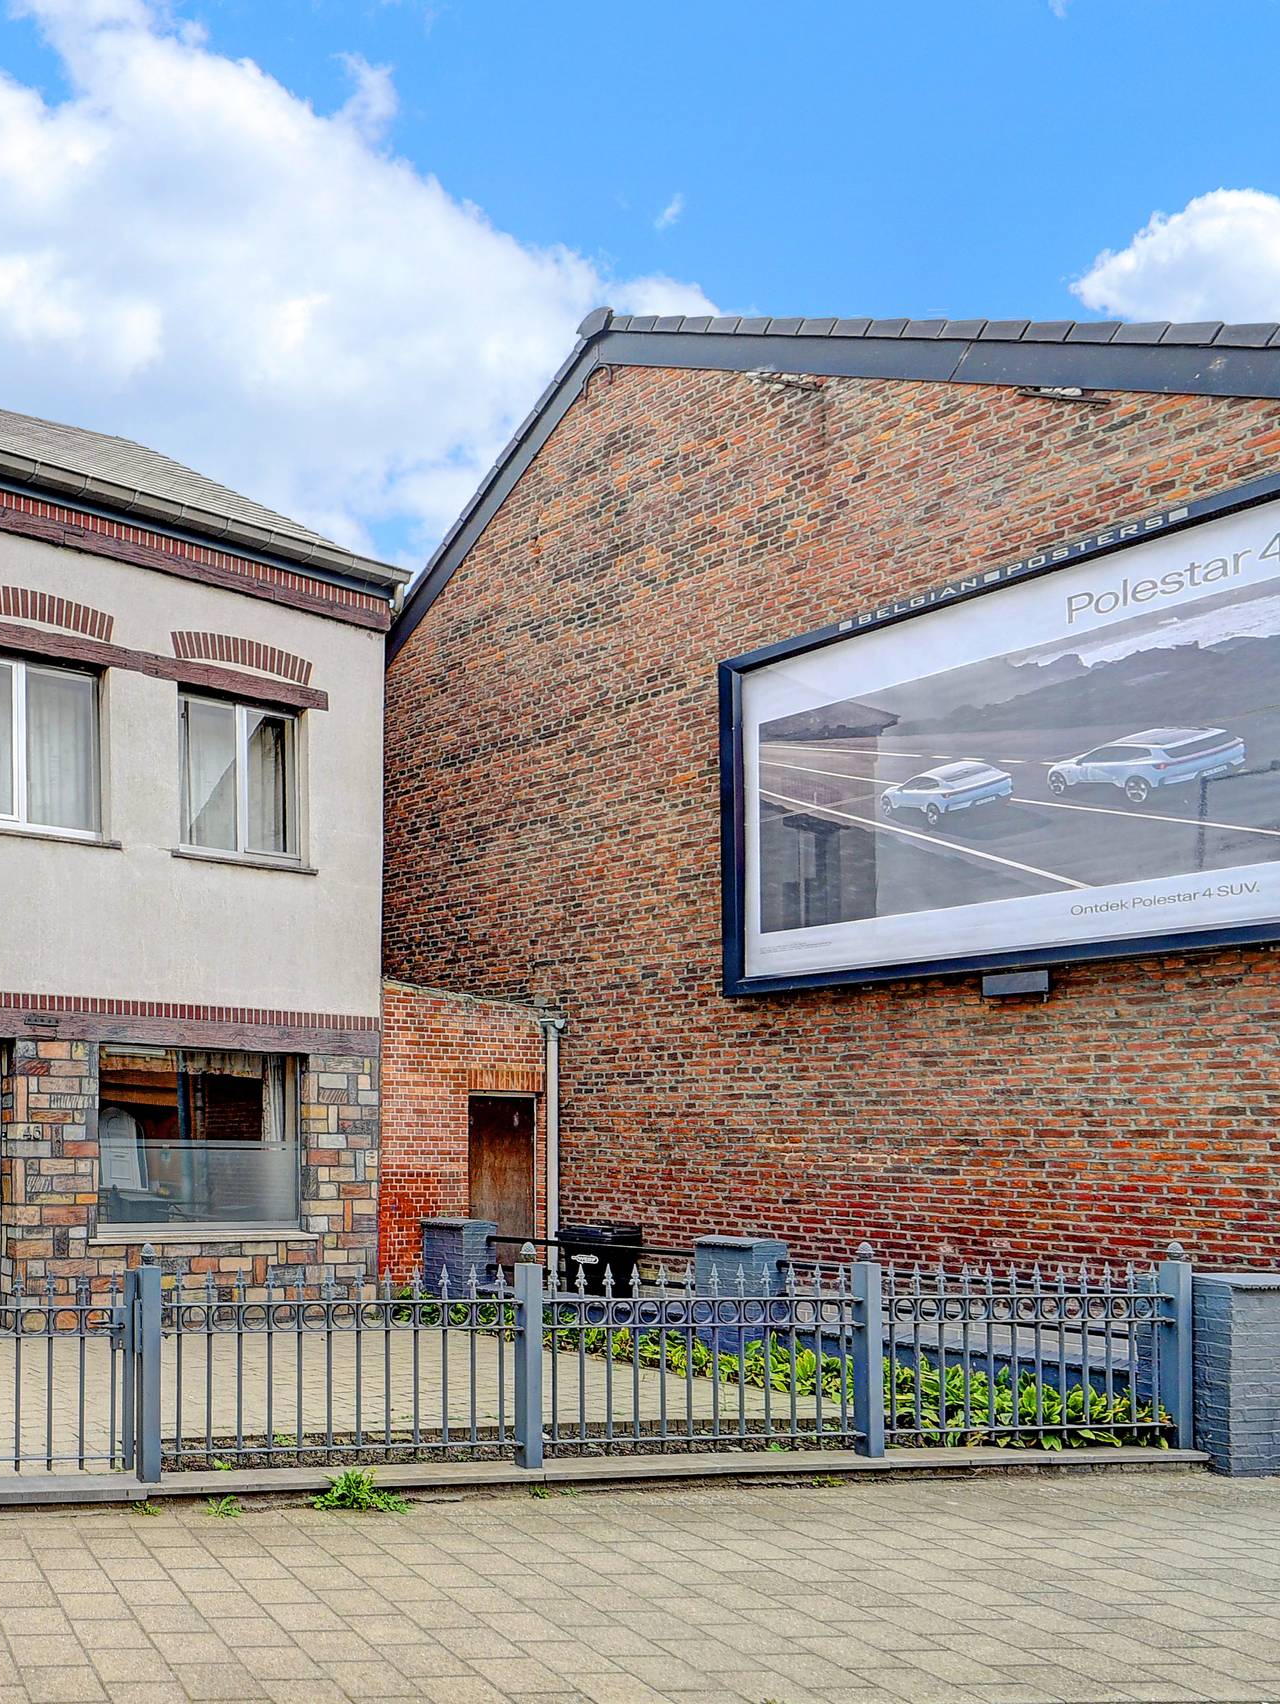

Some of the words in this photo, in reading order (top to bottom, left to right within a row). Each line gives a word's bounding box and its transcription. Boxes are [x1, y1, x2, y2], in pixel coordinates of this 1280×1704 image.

[858, 578, 978, 625] BELGIAN
[1006, 515, 1163, 576] POSTERS
[1066, 549, 1252, 624] Polestar
[1258, 531, 1280, 565] 4
[1070, 901, 1128, 916] Ontdek
[1131, 891, 1199, 909] Polestar
[1202, 887, 1214, 899] 4
[1217, 880, 1260, 898] SUV.
